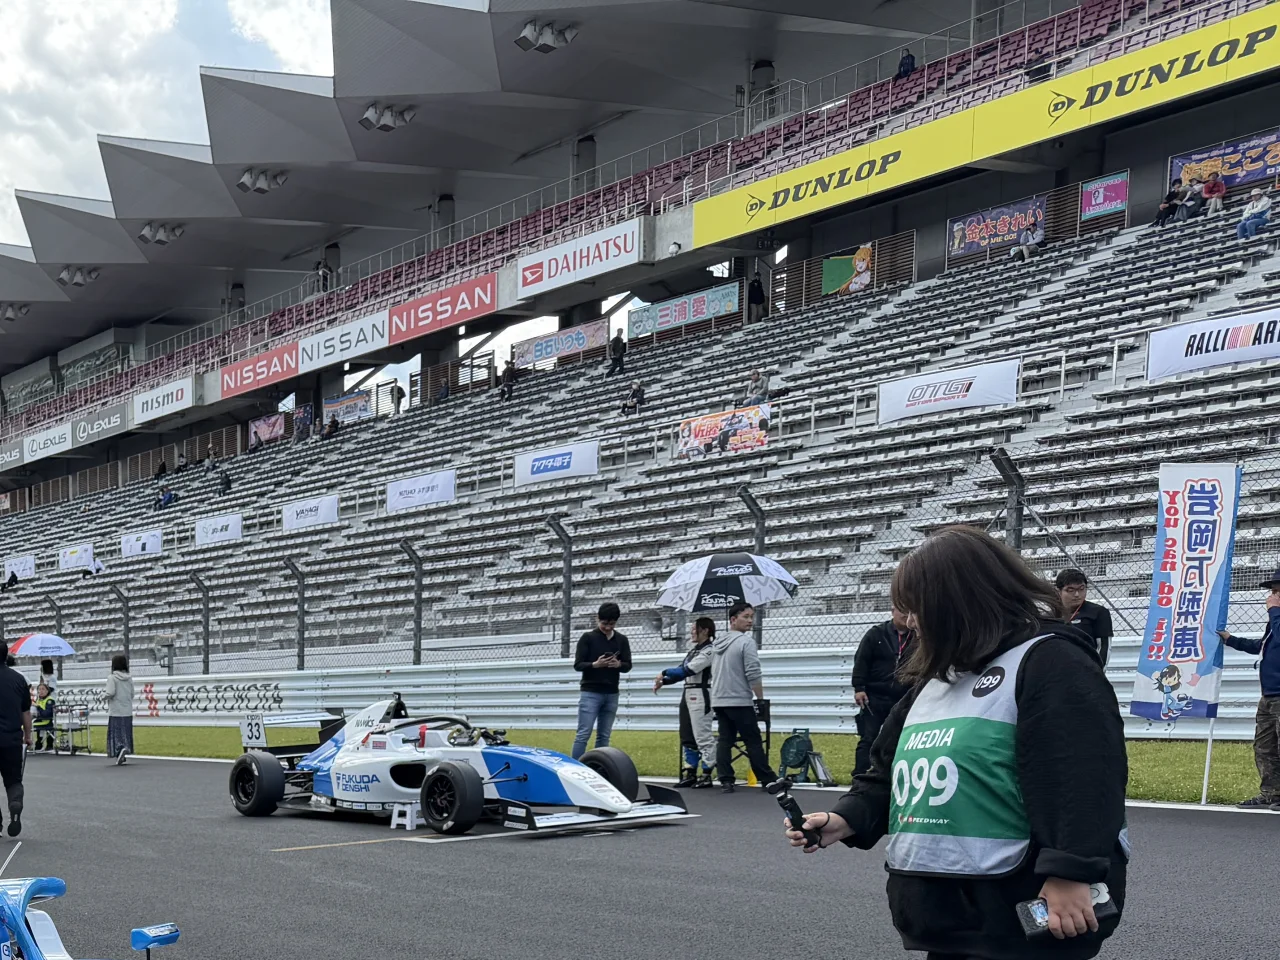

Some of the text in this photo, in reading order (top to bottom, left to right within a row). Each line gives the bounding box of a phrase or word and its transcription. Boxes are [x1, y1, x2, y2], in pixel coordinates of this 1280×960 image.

[1079, 24, 1278, 110] DUNLOP
[768, 150, 901, 211] DUNLOP
[965, 208, 1043, 243] 金本きれい
[547, 230, 635, 279] DAIHATSU
[392, 281, 491, 332] NISSAN
[301, 318, 385, 364] NISSAN
[223, 350, 296, 391] NISSAN
[89, 414, 120, 434] LEXUS
[37, 432, 67, 452] LEXUS
[532, 455, 572, 472] フクダ電子
[975, 675, 1001, 689] 099
[247, 722, 261, 740] 33
[904, 727, 956, 751] MEDIA
[341, 773, 381, 784] FUKUDA
[341, 784, 371, 792] DENSHI
[892, 755, 959, 807] 099
